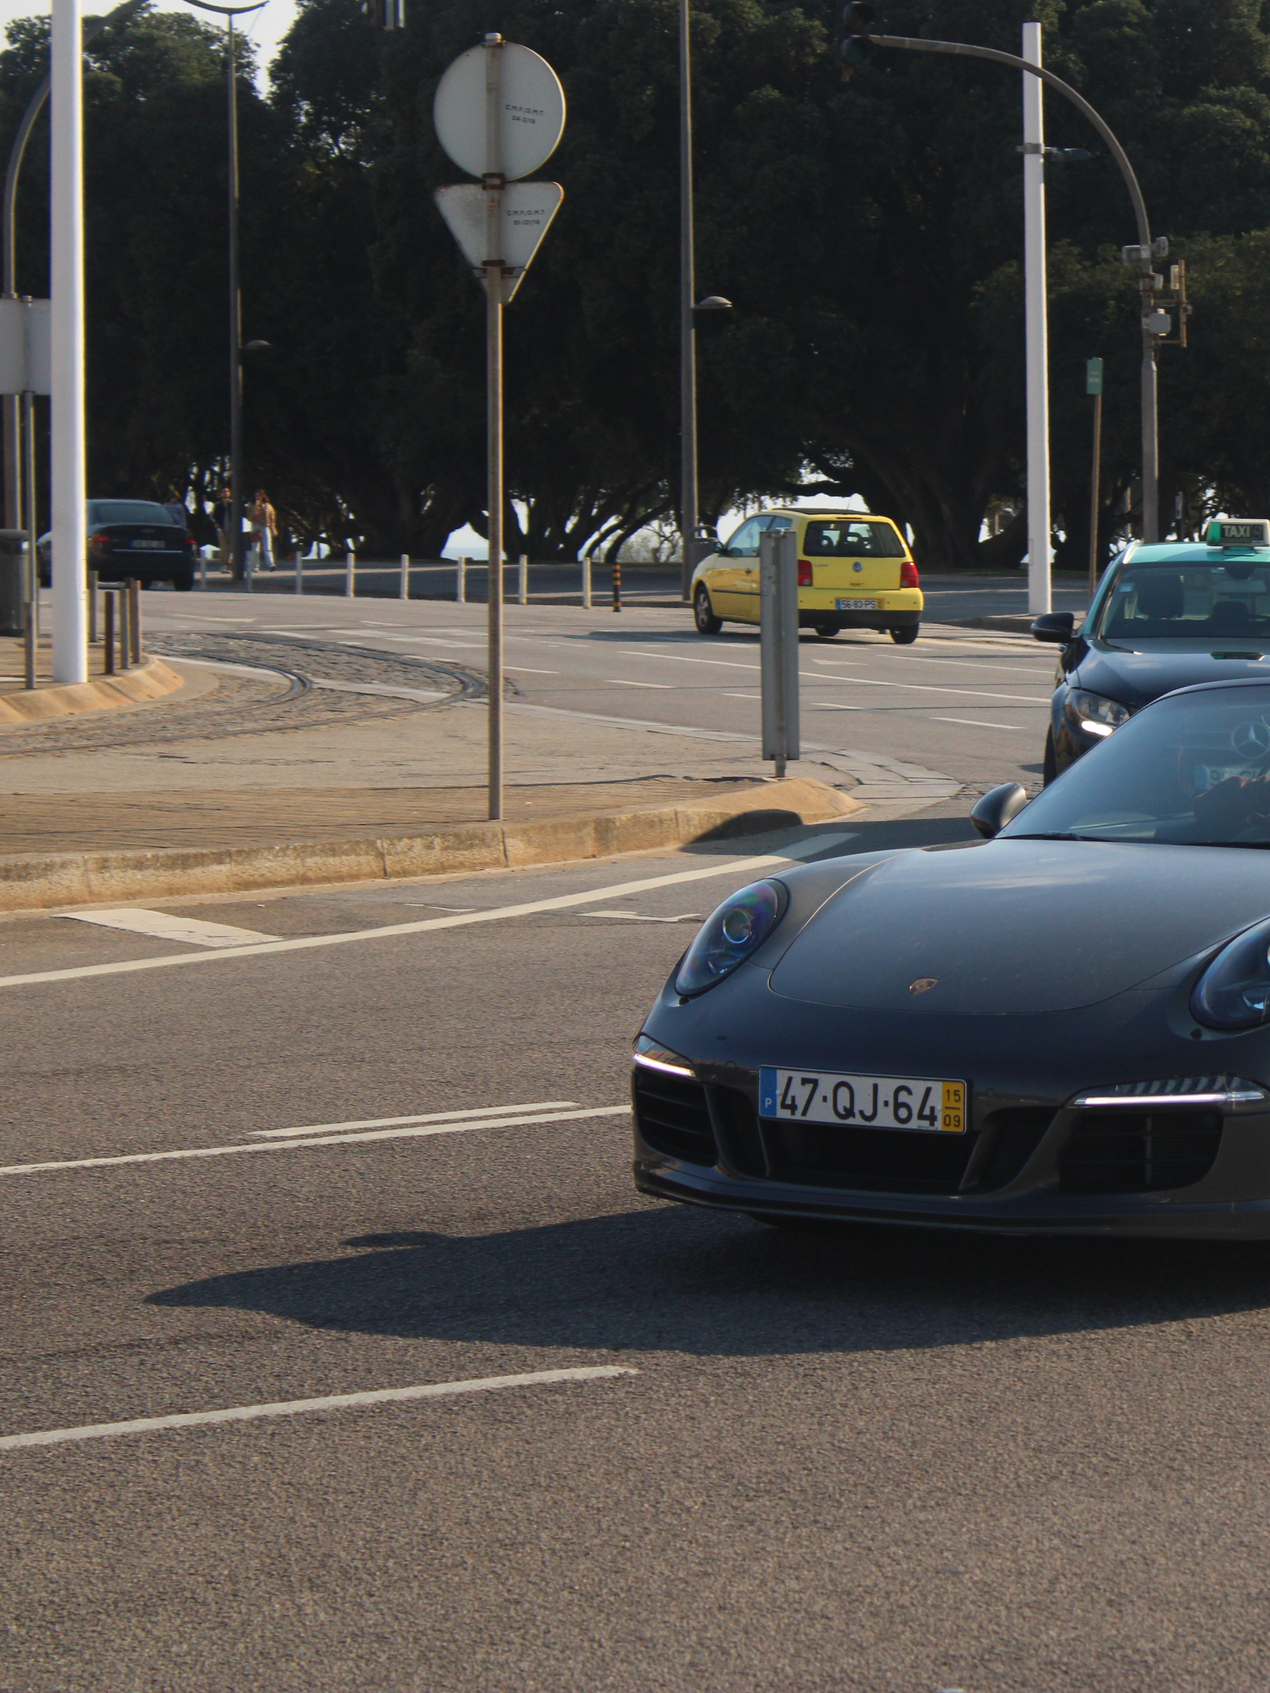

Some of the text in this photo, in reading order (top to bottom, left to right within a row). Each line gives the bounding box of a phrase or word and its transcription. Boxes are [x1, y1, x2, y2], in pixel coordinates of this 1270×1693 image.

[1222, 525, 1251, 538] TAXI
[764, 1097, 772, 1108] P
[945, 1089, 961, 1103] 15
[943, 1113, 961, 1128] 09
